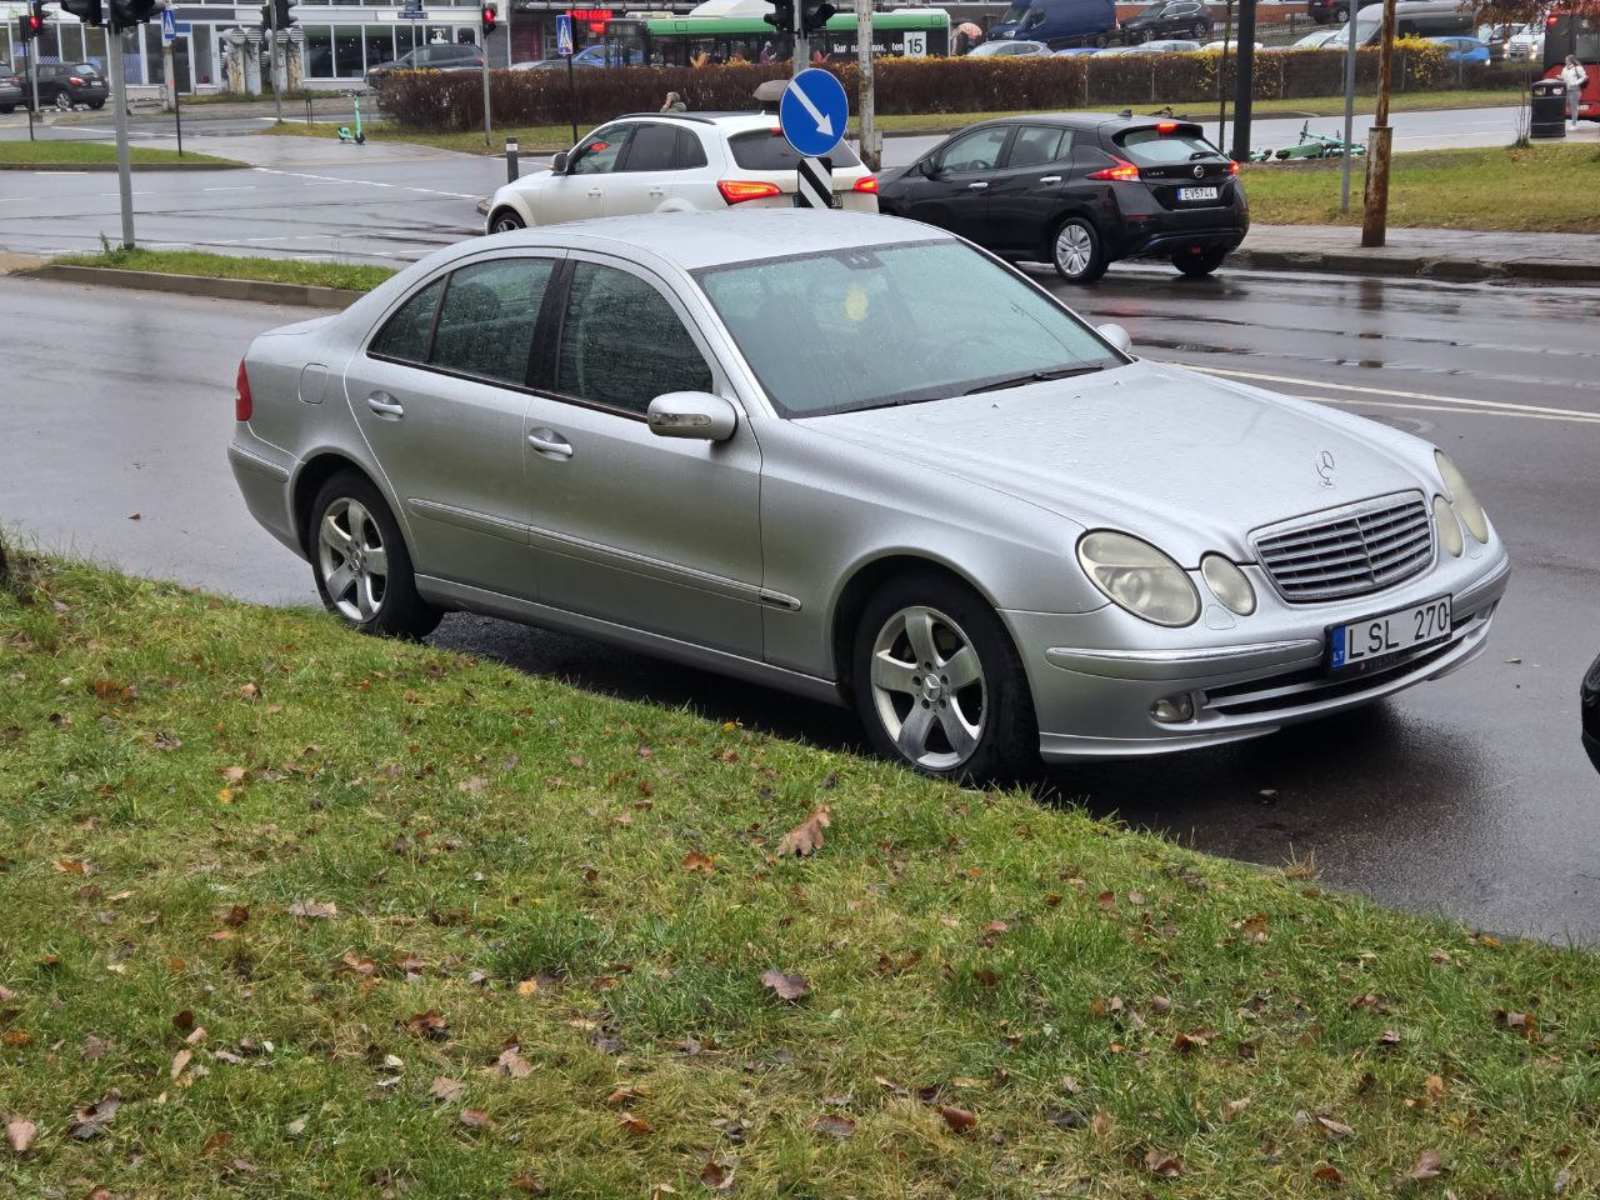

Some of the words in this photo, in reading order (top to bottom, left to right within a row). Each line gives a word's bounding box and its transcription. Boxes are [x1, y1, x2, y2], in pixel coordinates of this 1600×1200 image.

[907, 38, 924, 54] 15
[1349, 619, 1400, 659] LSL
[1414, 602, 1447, 641] 270
